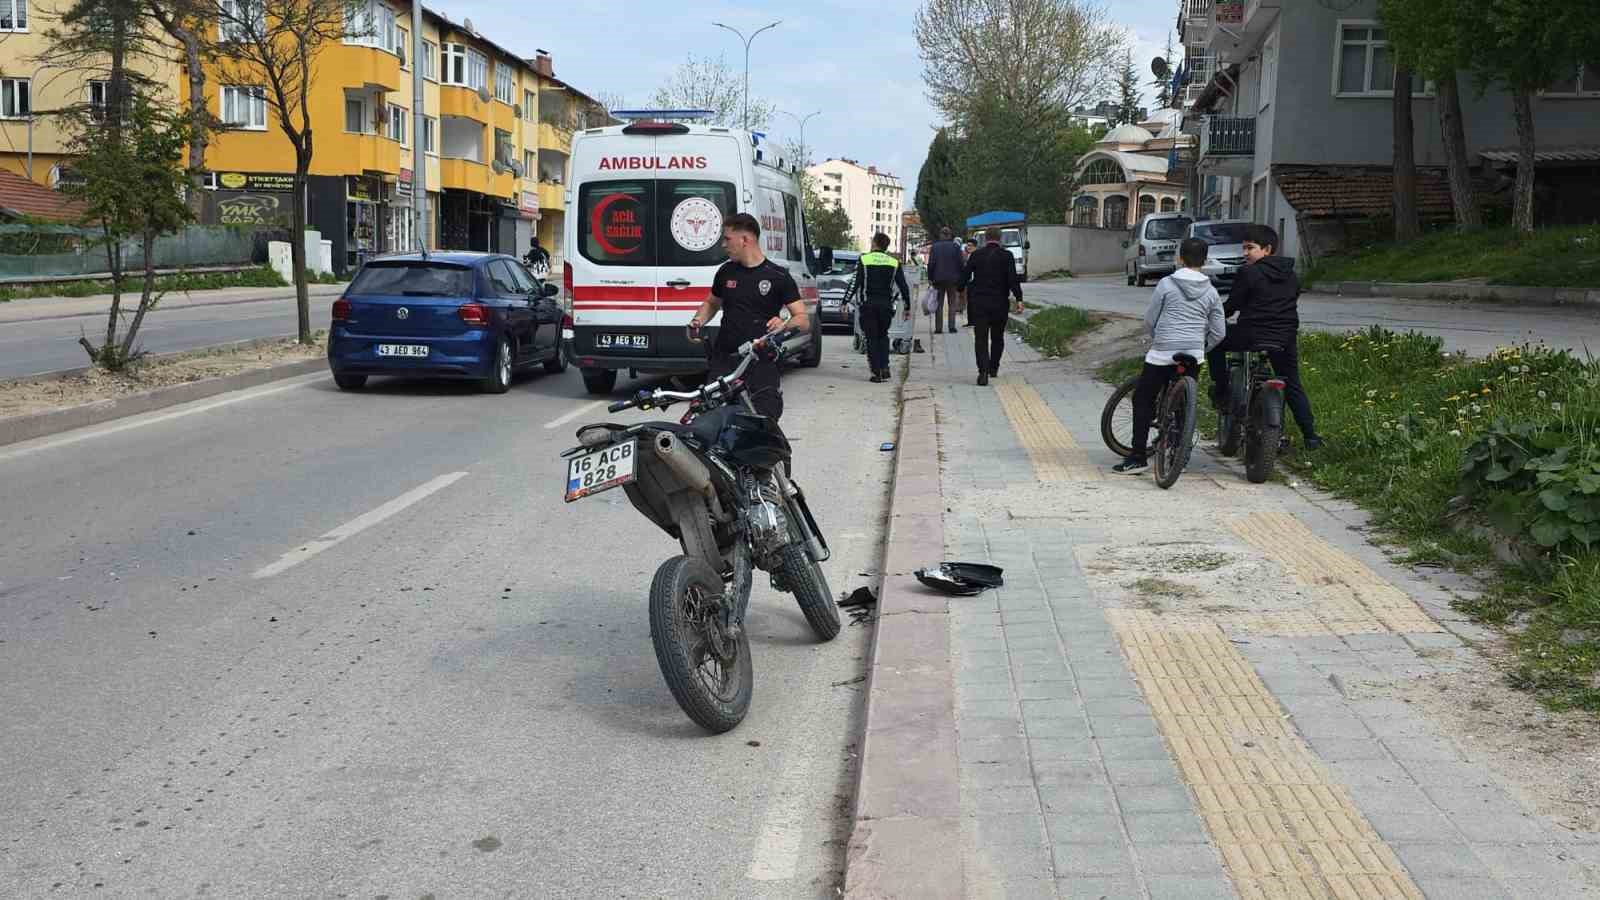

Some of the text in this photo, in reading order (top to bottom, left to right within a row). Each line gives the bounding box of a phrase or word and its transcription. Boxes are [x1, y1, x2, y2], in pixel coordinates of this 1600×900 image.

[598, 156, 707, 170] AMBULANS
[220, 204, 260, 216] YMK
[601, 335, 647, 345] 43 AEG 122
[379, 345, 390, 354] 43
[574, 444, 632, 474] 16 ACB
[583, 464, 617, 487] 828
